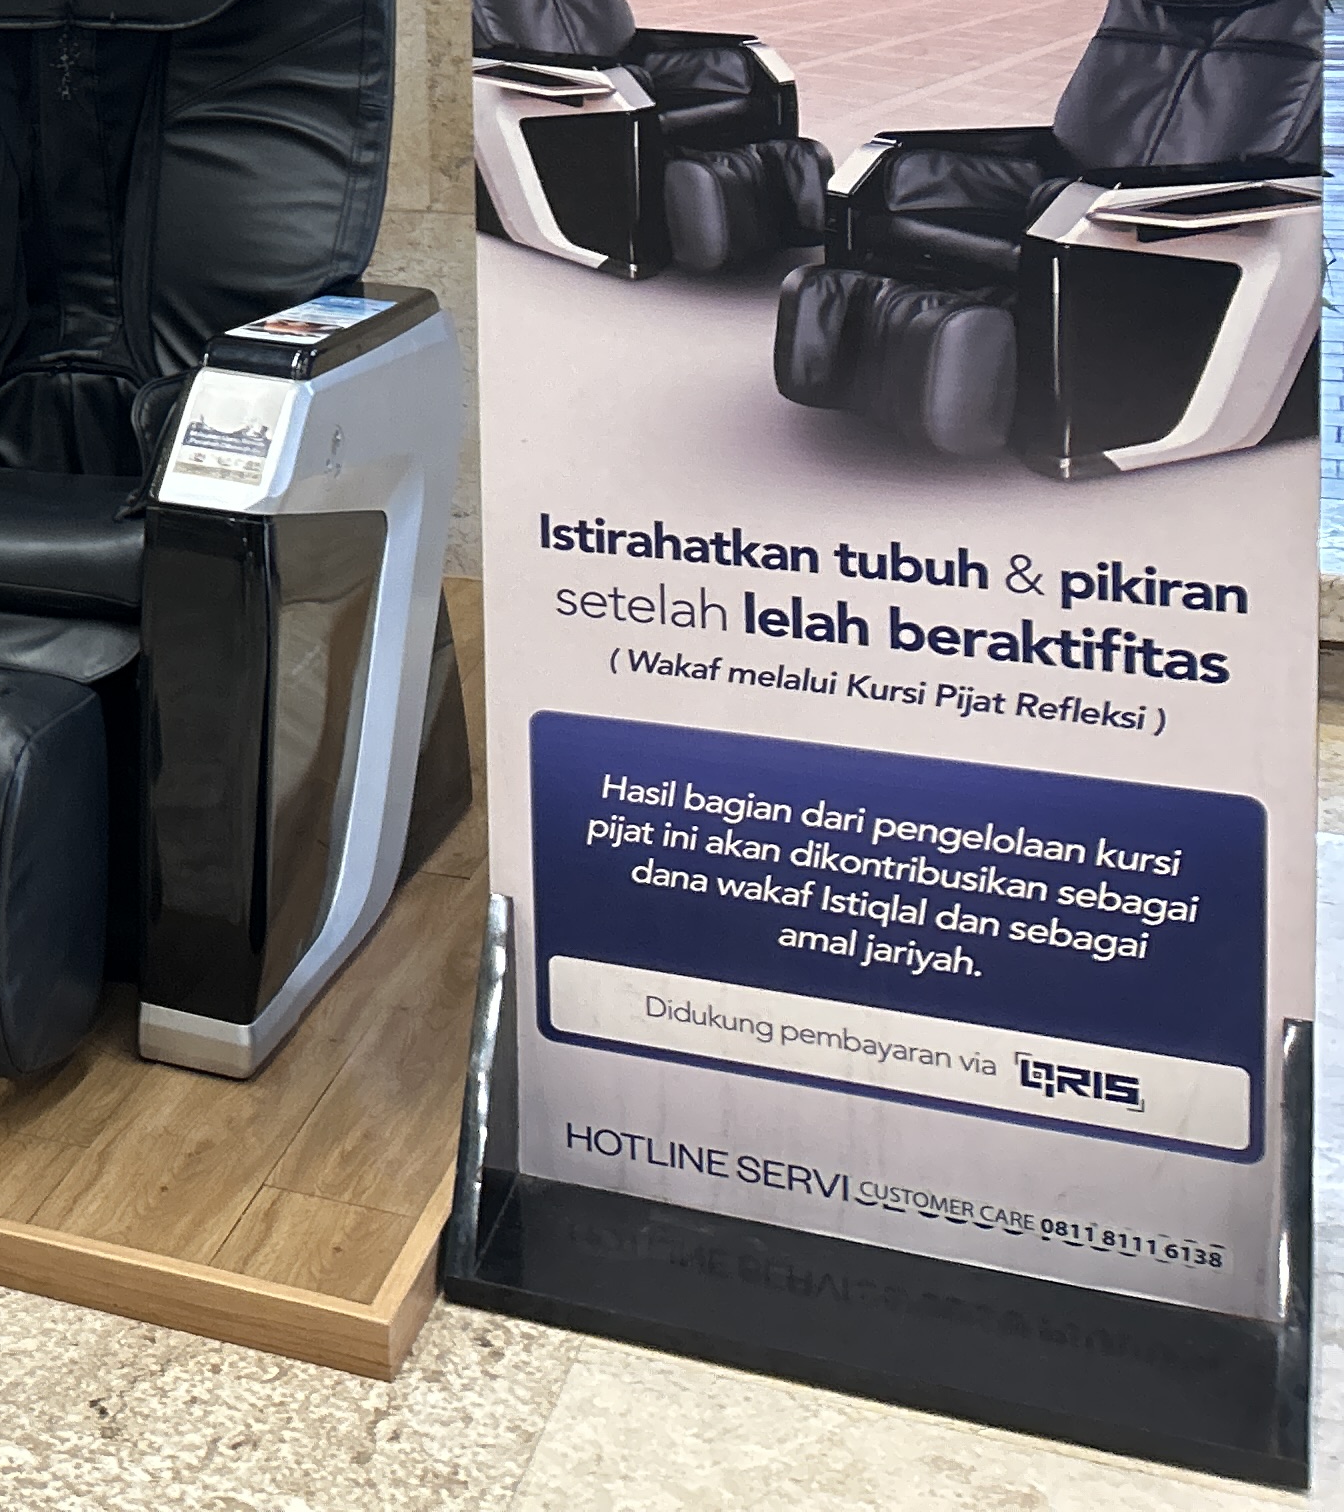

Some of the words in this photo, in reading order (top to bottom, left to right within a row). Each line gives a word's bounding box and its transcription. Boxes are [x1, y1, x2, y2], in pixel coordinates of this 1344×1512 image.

[540, 512, 819, 574] Istirahatkan
[833, 541, 989, 590] tubuh
[1005, 553, 1045, 596] &
[1061, 560, 1248, 614] pikiran
[555, 582, 728, 632] setelah
[744, 591, 869, 647] lelah
[889, 605, 1230, 684] beraktifitas
[727, 664, 838, 695] melalui
[846, 673, 927, 705] Kursi
[935, 683, 1007, 718] Pijat
[586, 819, 655, 848] pijat
[662, 821, 699, 851] ini
[704, 828, 781, 863] akan
[789, 839, 1048, 902] dikontribusikan
[1057, 880, 1200, 926] sebagai
[602, 773, 677, 807] Hasil
[683, 782, 792, 824] bagian
[800, 799, 866, 834] dari
[871, 817, 1086, 864] pengelolaan
[1095, 837, 1182, 877] kursi
[631, 857, 708, 893] dana
[716, 874, 816, 908] wakaf
[821, 885, 928, 928] Istiqlal
[935, 902, 1000, 937] dan
[1008, 917, 1150, 962] sebagai
[777, 928, 858, 957] amal
[860, 933, 982, 977] jariyah.
[645, 995, 774, 1044] Didukung
[780, 1024, 952, 1069] pembayaran
[958, 1051, 997, 1076] via
[1019, 1056, 1142, 1107] QRIS
[566, 1122, 730, 1179] HOTLINE
[736, 1155, 849, 1202] SERVI
[859, 1181, 974, 1218] CUSTOMER
[979, 1205, 1036, 1231] CARE
[1040, 1218, 1098, 1243] 0811
[1101, 1230, 1156, 1255] 8111
[1164, 1243, 1223, 1268] 6138
